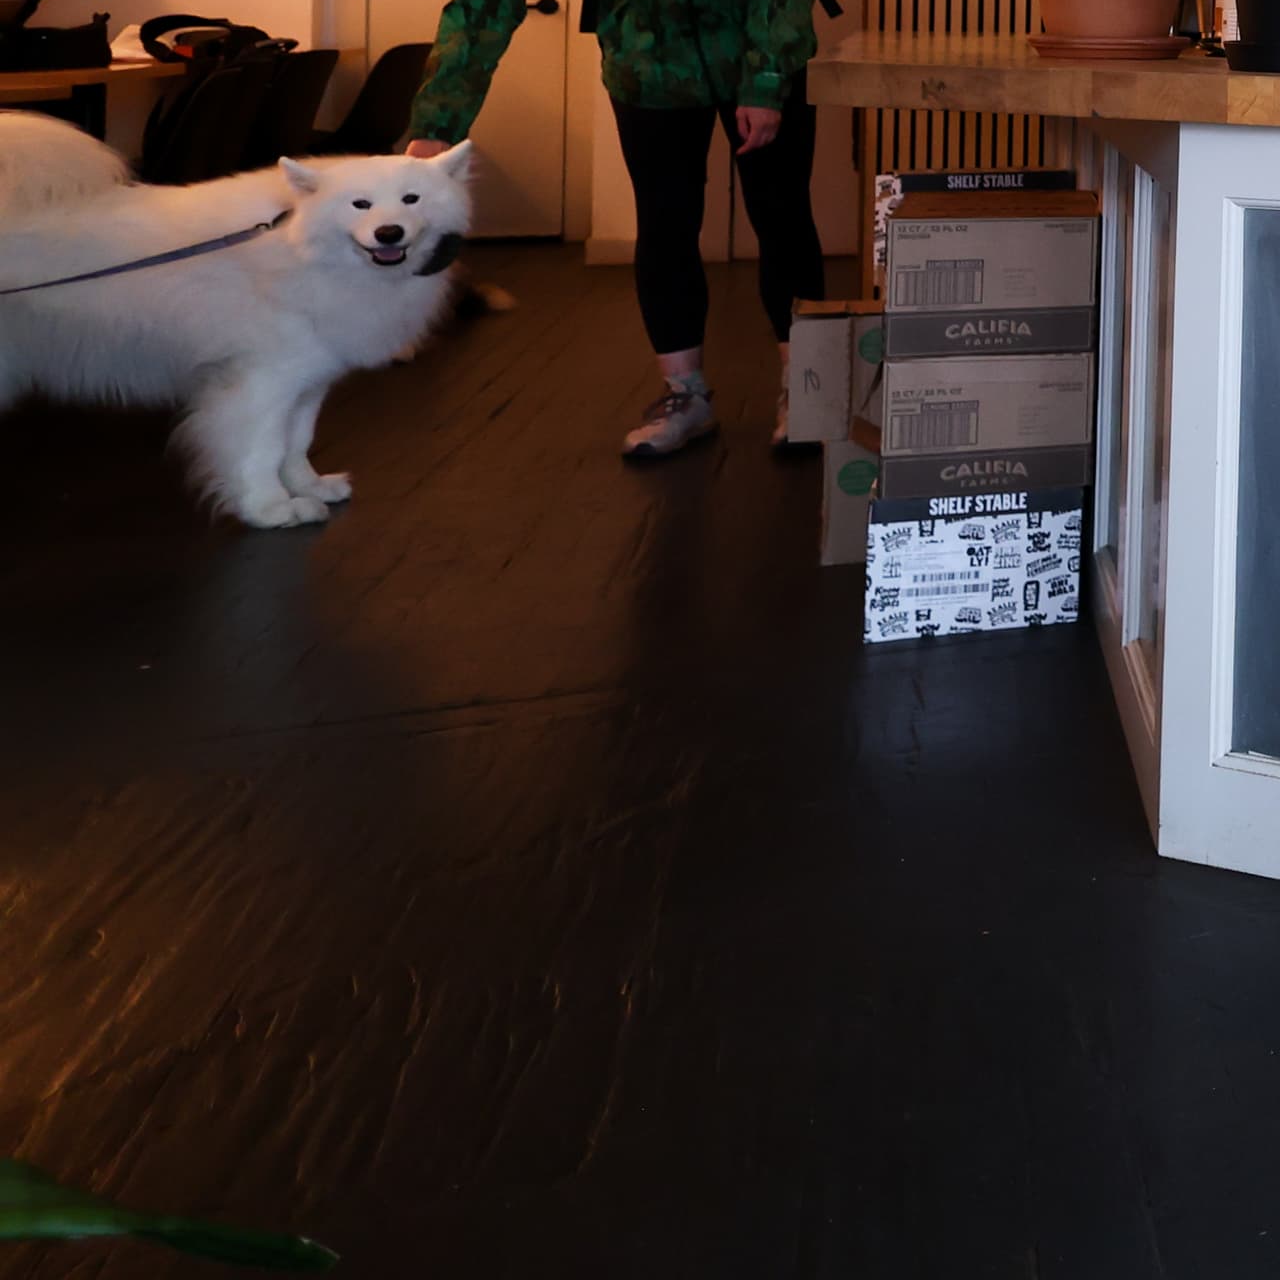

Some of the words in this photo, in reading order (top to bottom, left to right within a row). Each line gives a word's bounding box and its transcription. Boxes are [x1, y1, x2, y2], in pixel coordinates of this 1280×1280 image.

[947, 174, 982, 189] SHELF
[983, 173, 1024, 188] STABLE
[945, 319, 1032, 339] CALIFIA
[940, 459, 1029, 481] CALIFIA
[928, 496, 972, 516] SHELF
[974, 492, 1028, 513] STABLE
